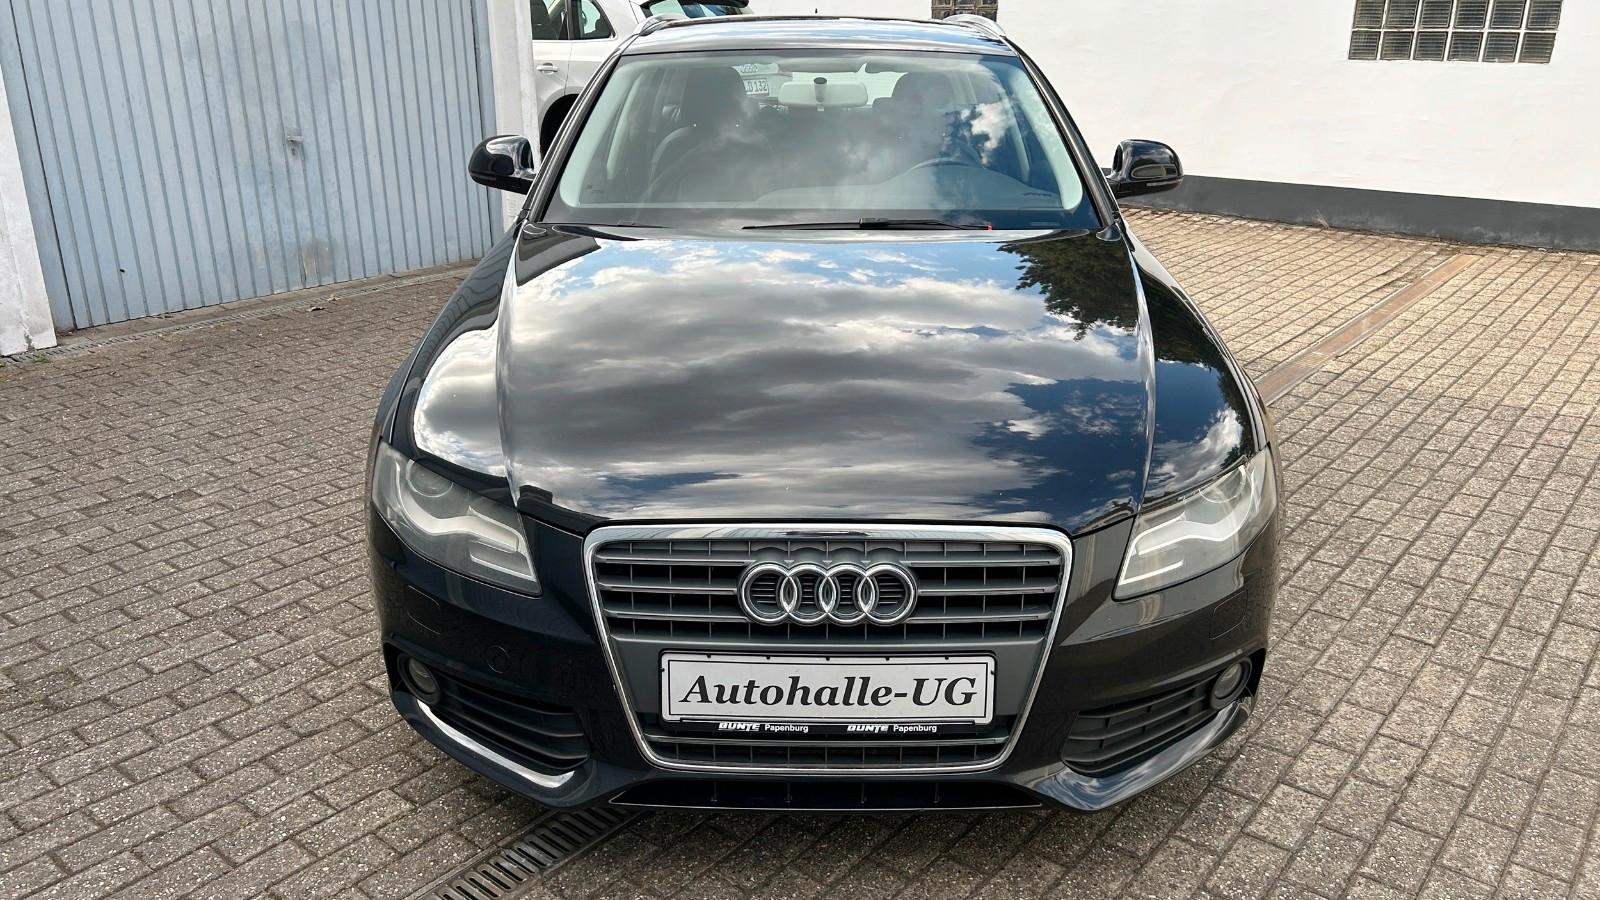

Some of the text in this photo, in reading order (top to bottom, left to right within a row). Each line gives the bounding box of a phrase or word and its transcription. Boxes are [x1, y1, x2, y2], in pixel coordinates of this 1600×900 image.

[753, 80, 767, 91] 132
[678, 675, 977, 706] Autohalle-UG
[764, 724, 809, 733] Papenburg
[893, 724, 938, 733] Papenburg
